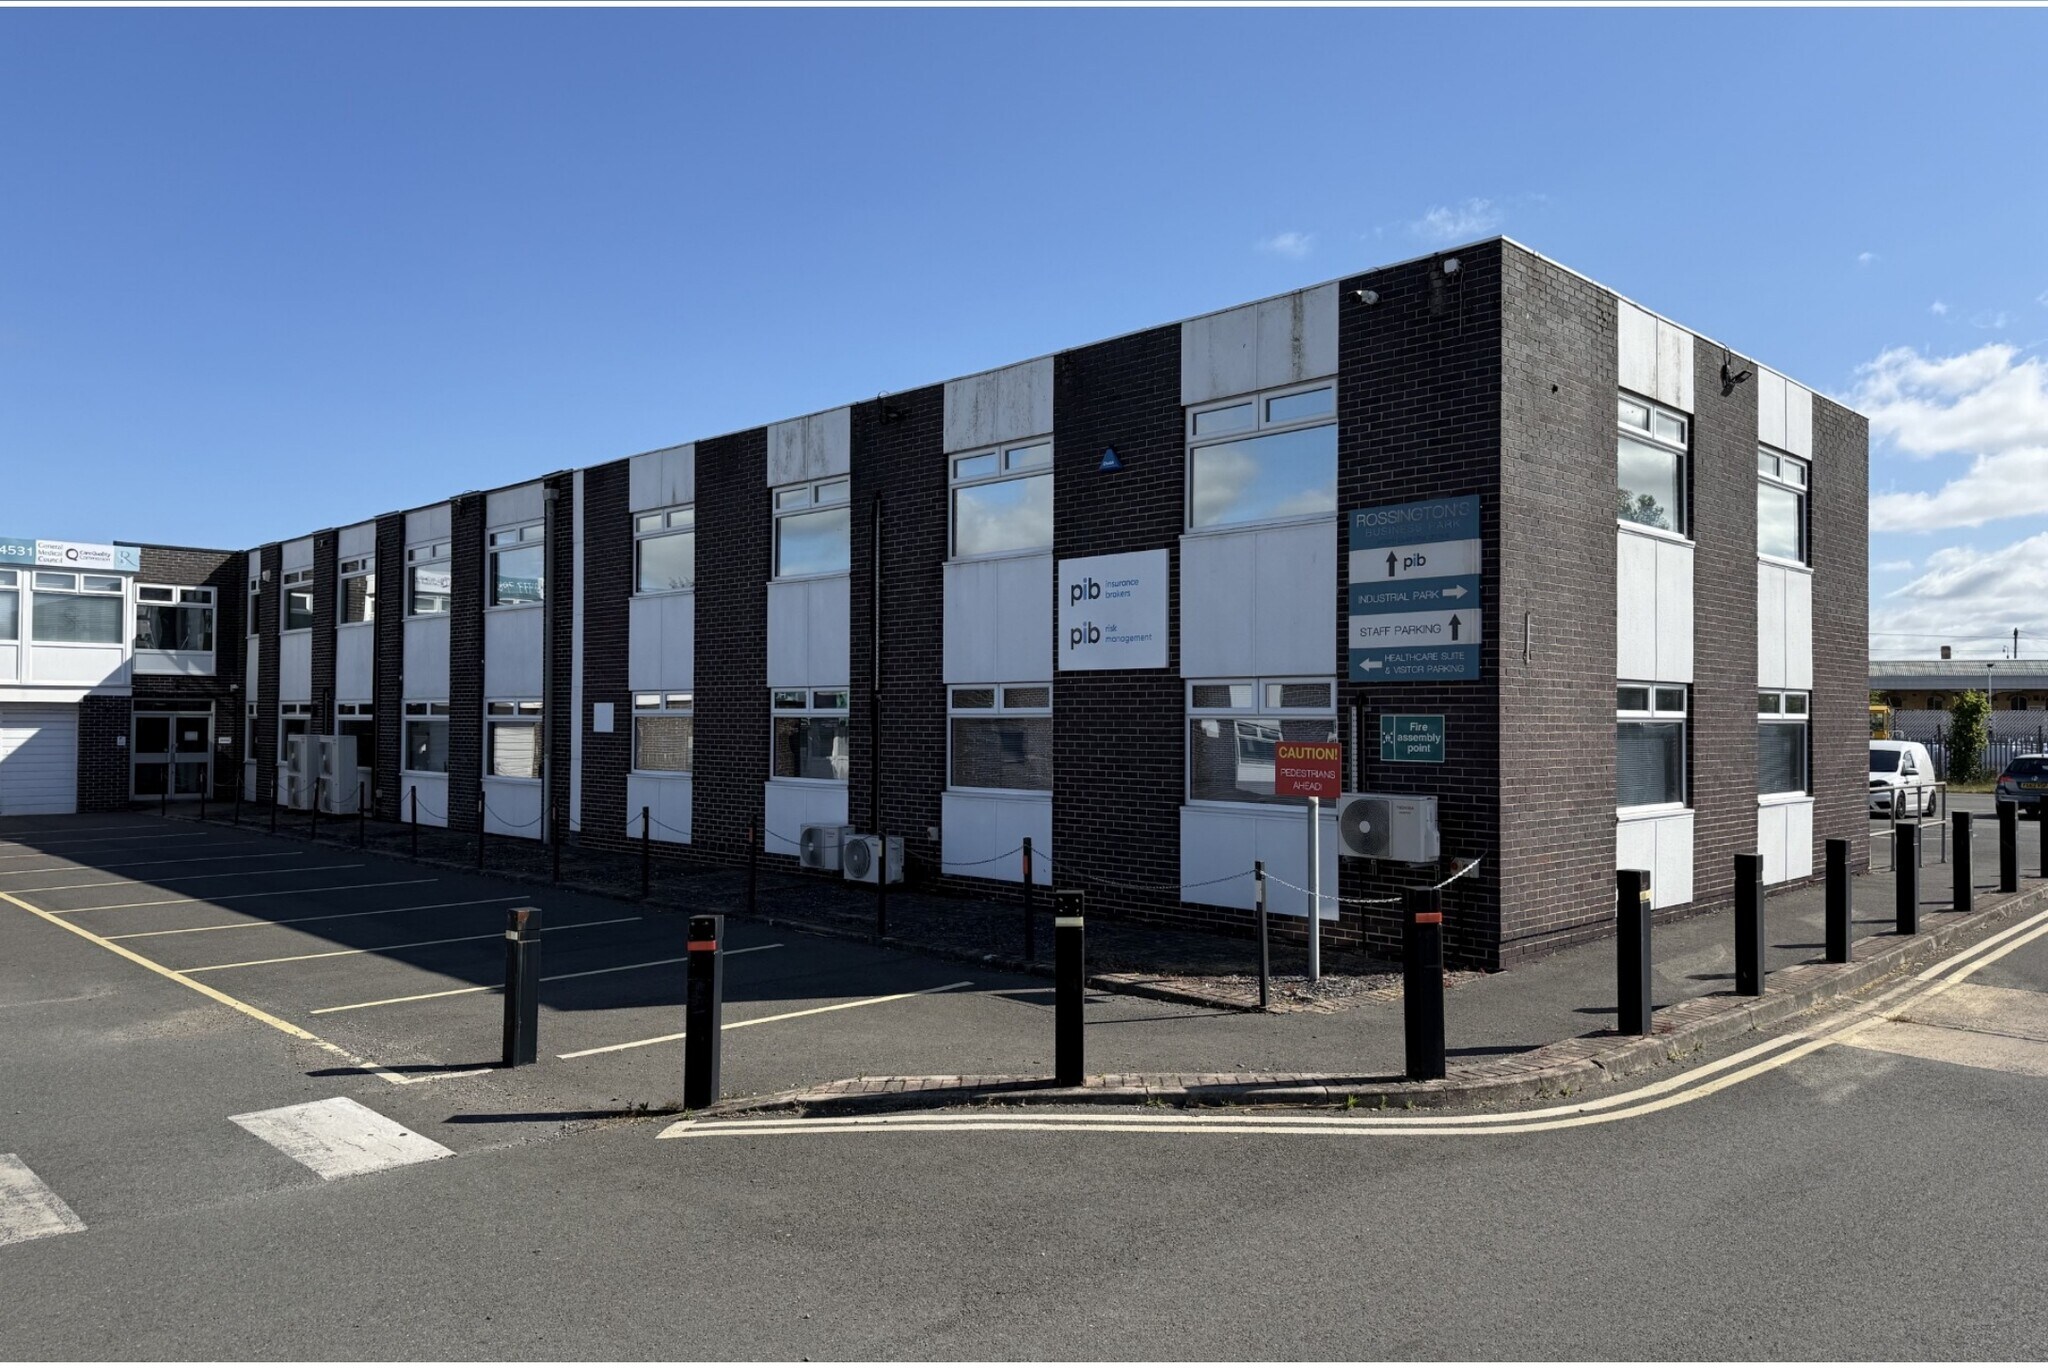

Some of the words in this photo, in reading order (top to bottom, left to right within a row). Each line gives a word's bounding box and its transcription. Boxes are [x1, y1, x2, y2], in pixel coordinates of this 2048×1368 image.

[1356, 502, 1470, 528] ROSSINGTON'S
[1365, 524, 1422, 537] BUSINESS
[1428, 519, 1460, 530] PARK
[0, 545, 33, 557] 4531
[38, 542, 63, 550] General
[38, 549, 63, 557] Medical
[38, 556, 63, 564] Council
[1403, 553, 1426, 571] pib
[1105, 579, 1139, 588] insurance
[1071, 577, 1100, 607] pib
[1105, 589, 1131, 599] brokers
[1359, 592, 1409, 604] INDUSTRIAL
[1412, 590, 1440, 600] PARK
[1105, 624, 1117, 632] risk
[1360, 626, 1391, 637] STAFF
[1394, 623, 1441, 635] PARKING
[1071, 621, 1100, 650] pib
[1105, 633, 1152, 644] management
[1384, 652, 1438, 662] HEALTHCARE
[1441, 651, 1464, 660] SUITE
[1394, 665, 1424, 674] VISITOR
[1427, 664, 1464, 673] PARKING
[1409, 722, 1428, 731] Fire
[1397, 733, 1441, 744] assembly
[1279, 746, 1338, 760] CAUTION!
[1407, 744, 1431, 754] point
[1280, 768, 1336, 779] PEDESTRIANS
